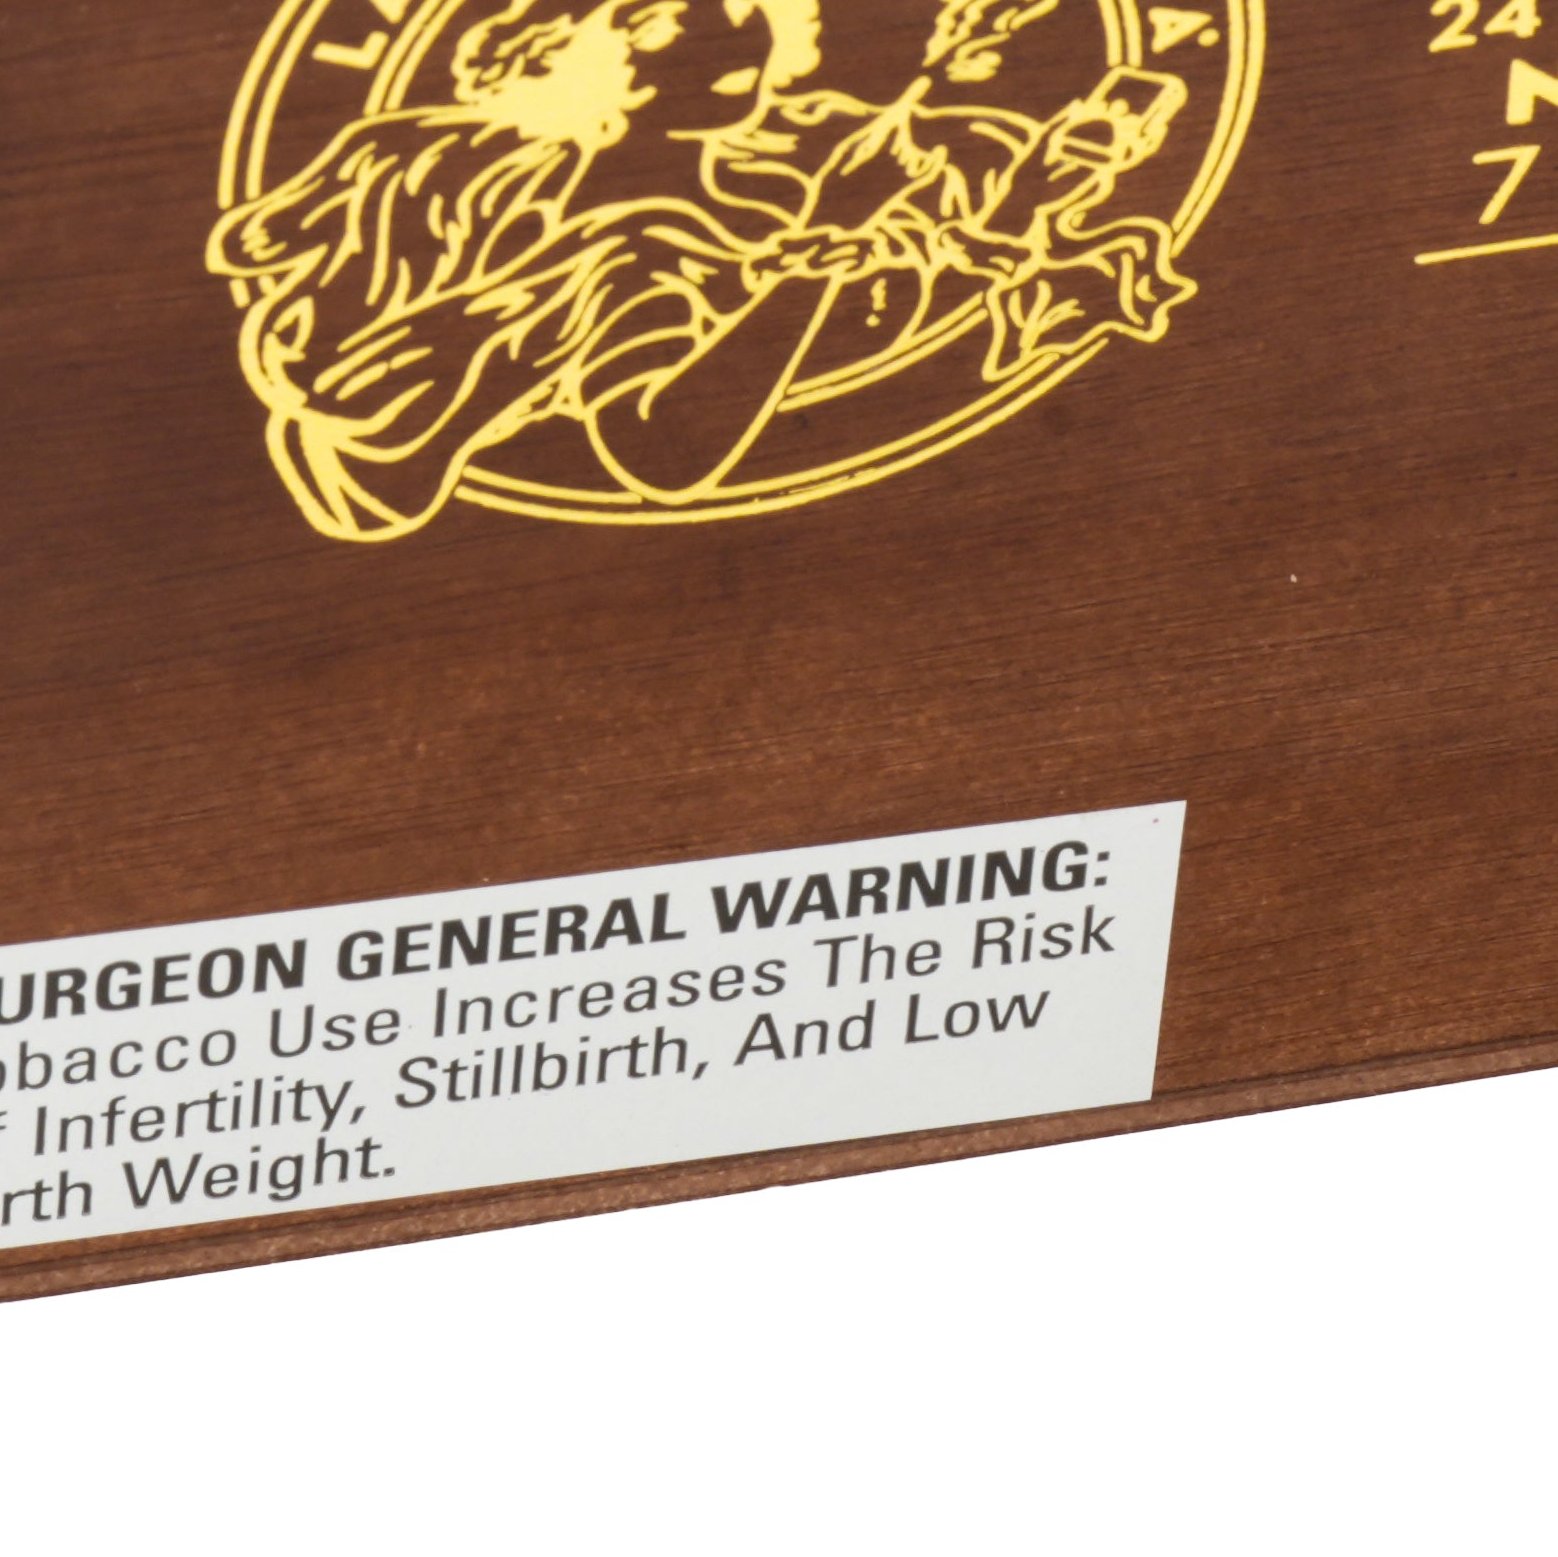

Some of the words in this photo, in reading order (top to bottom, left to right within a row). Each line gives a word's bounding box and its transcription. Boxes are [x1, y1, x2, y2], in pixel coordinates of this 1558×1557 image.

[1473, 145, 1540, 224] 7
[338, 894, 685, 980] GENERAL
[712, 841, 1109, 933] WARNING:
[271, 1005, 399, 1057] Use
[435, 960, 785, 1037] Increases
[815, 934, 940, 987] The
[973, 906, 1113, 968] Risk
[35, 1076, 363, 1155] Infertility,
[396, 1027, 707, 1108] Stillbirth,
[735, 1000, 875, 1065] And
[906, 992, 1049, 1043] Low
[123, 1137, 394, 1207] Weight.
